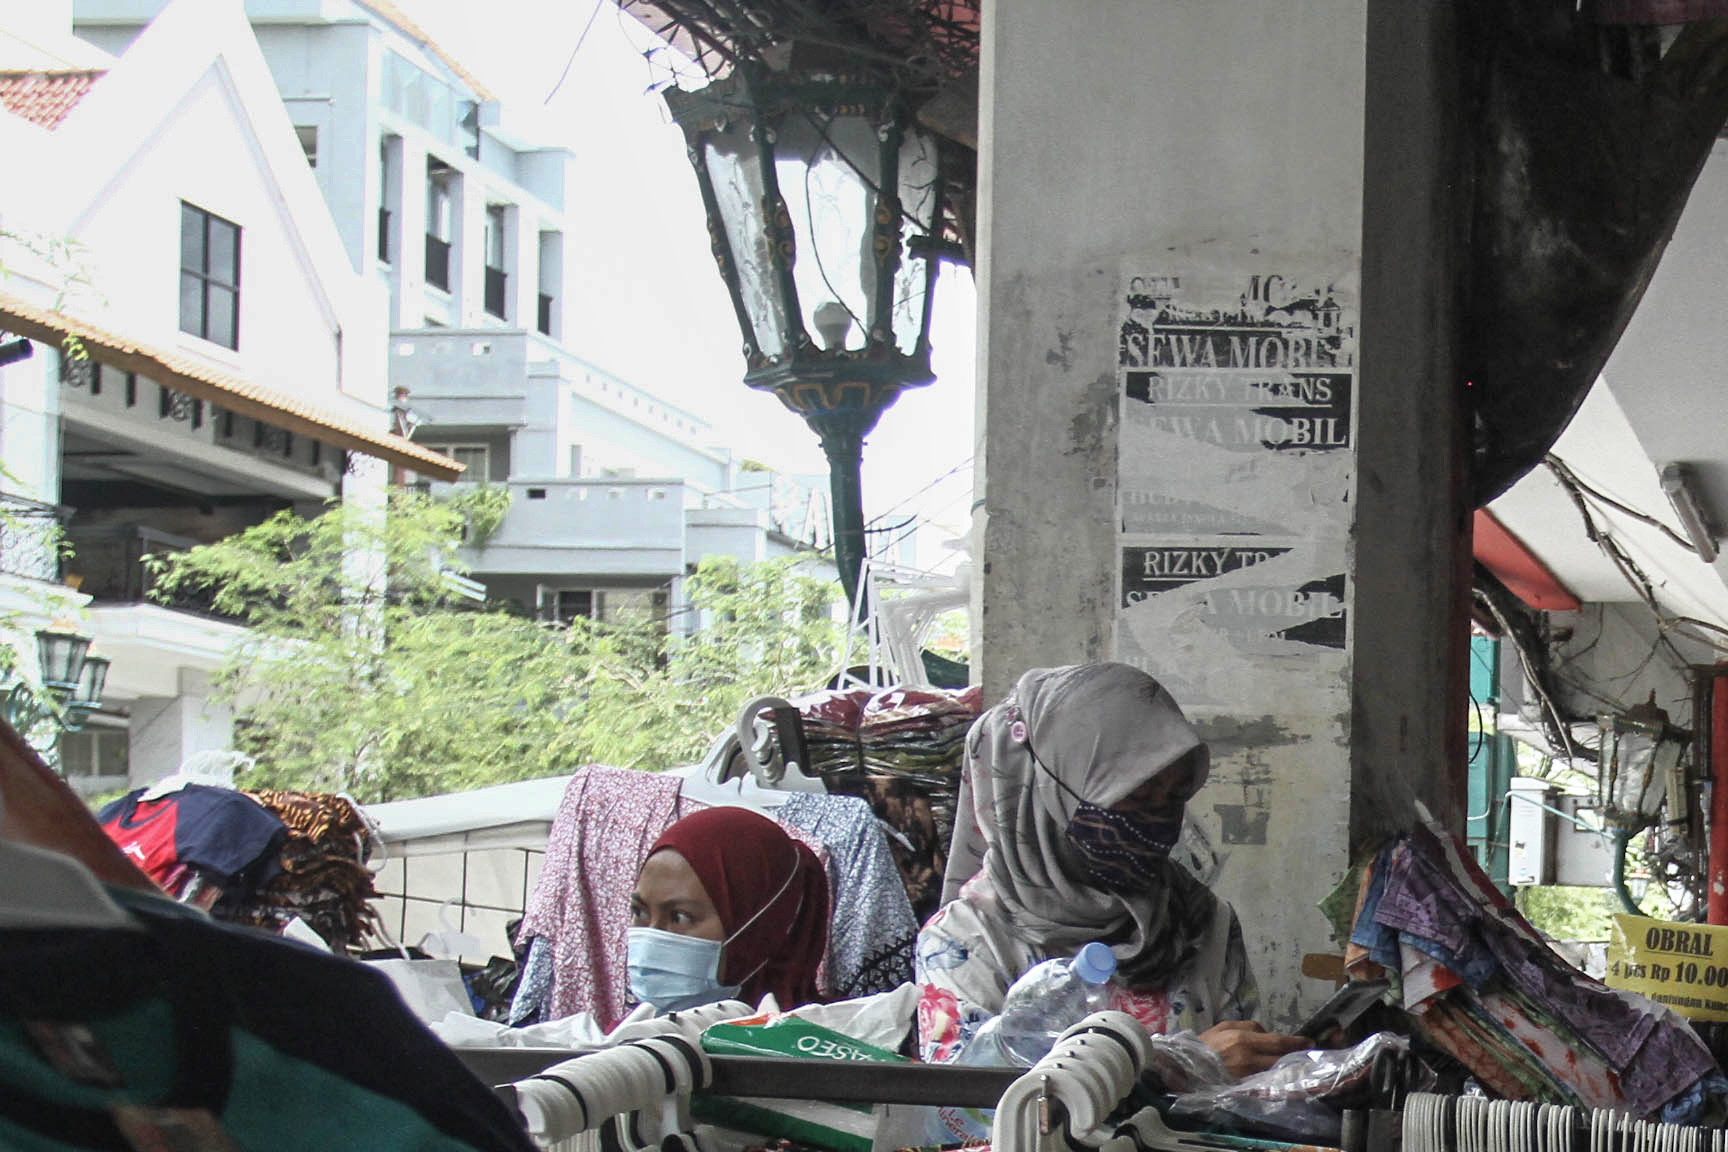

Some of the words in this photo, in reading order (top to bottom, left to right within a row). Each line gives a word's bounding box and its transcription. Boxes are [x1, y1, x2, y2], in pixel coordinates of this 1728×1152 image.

[1148, 375, 1227, 402] RIZKY
[1241, 377, 1333, 402] TRANS
[1236, 416, 1347, 447] MOBIL
[1143, 549, 1230, 576] RIZKY
[1645, 926, 1714, 955] OBRAL
[1611, 959, 1620, 977] 4
[1624, 962, 1647, 979] pcs
[1651, 963, 1670, 983] Rp
